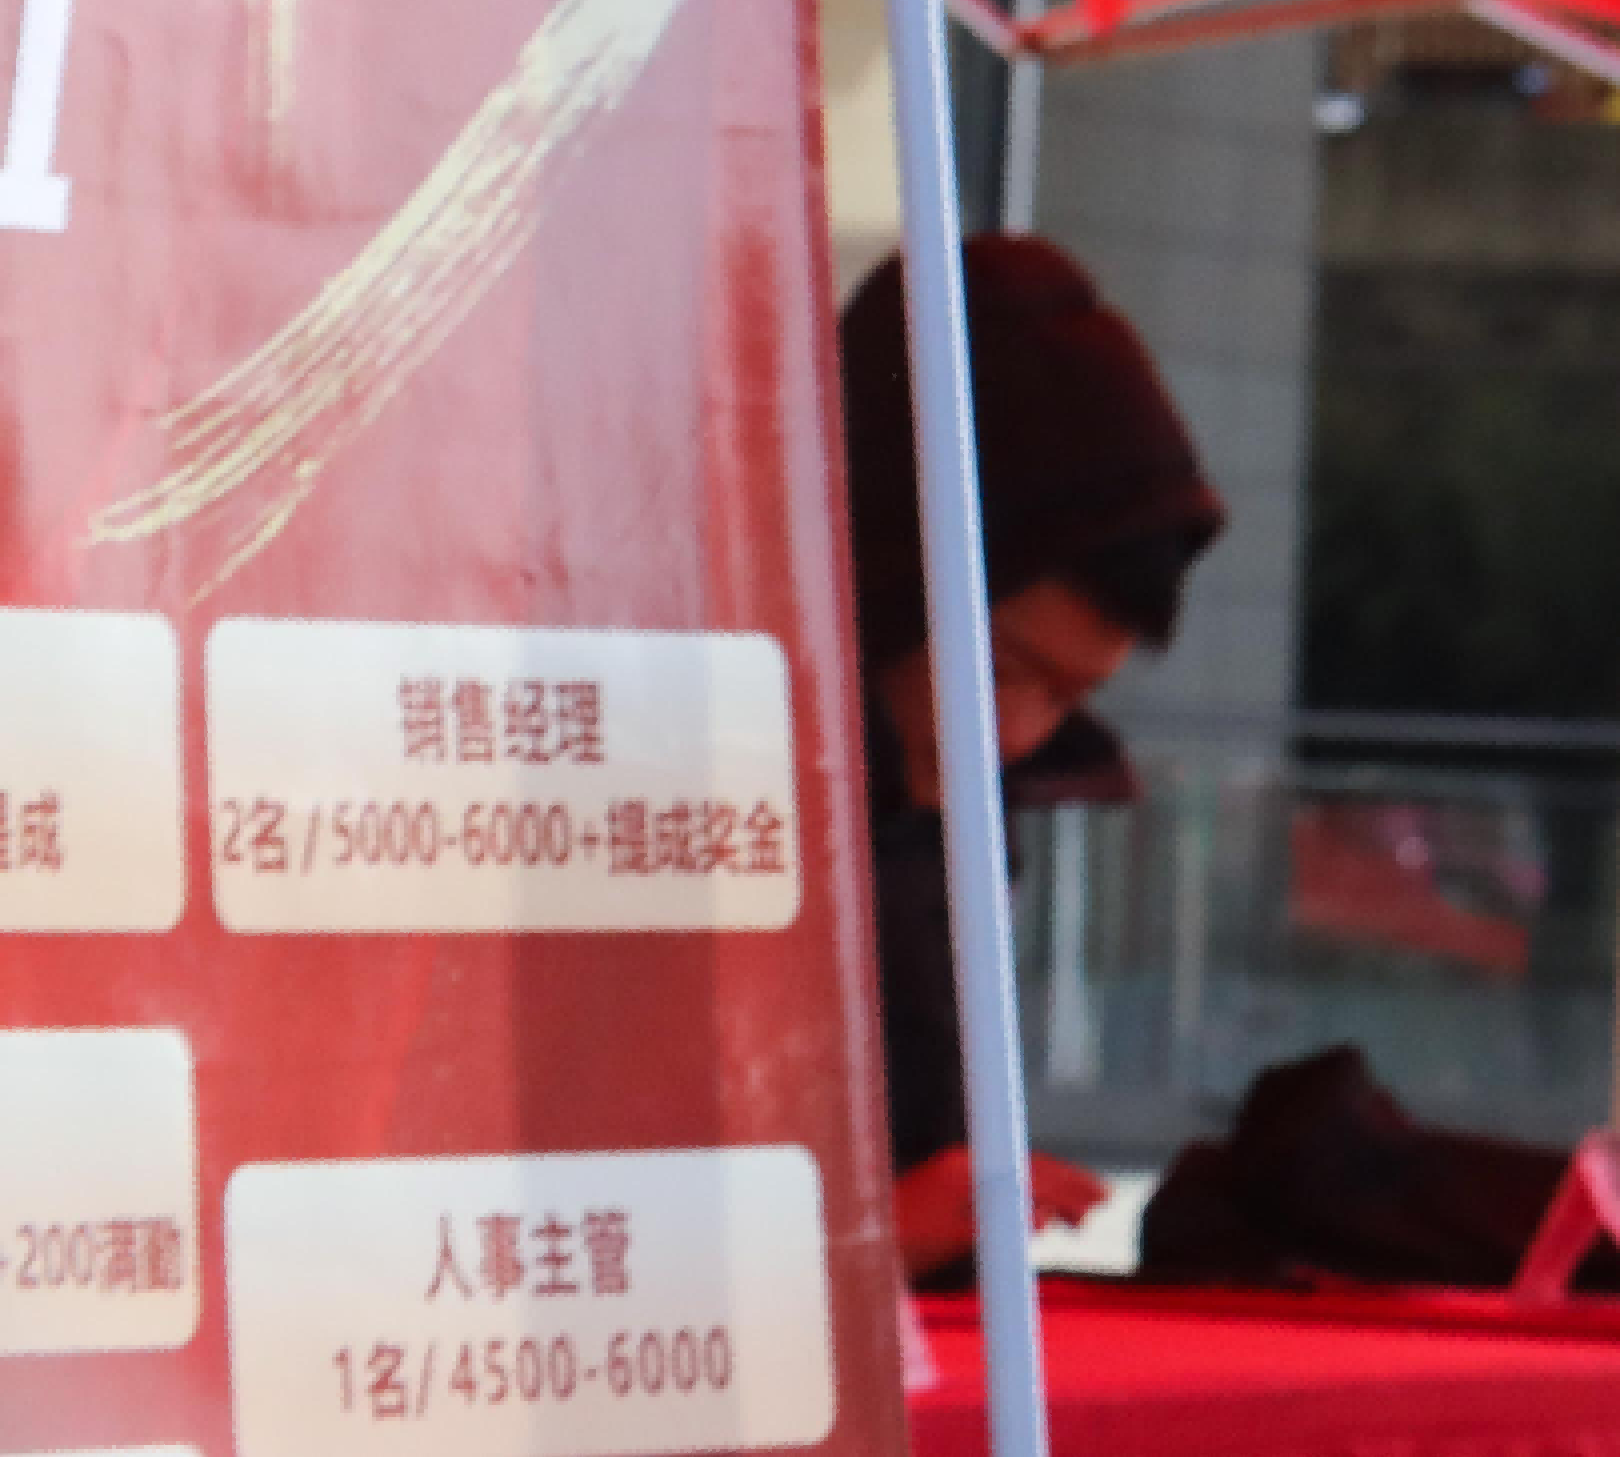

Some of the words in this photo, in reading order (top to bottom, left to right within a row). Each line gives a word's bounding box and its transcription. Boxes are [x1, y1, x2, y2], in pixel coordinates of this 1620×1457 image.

[398, 675, 607, 767] 销售经理
[424, 1207, 632, 1301] 人事主管
[331, 1325, 735, 1421] 1名/4500-6000
